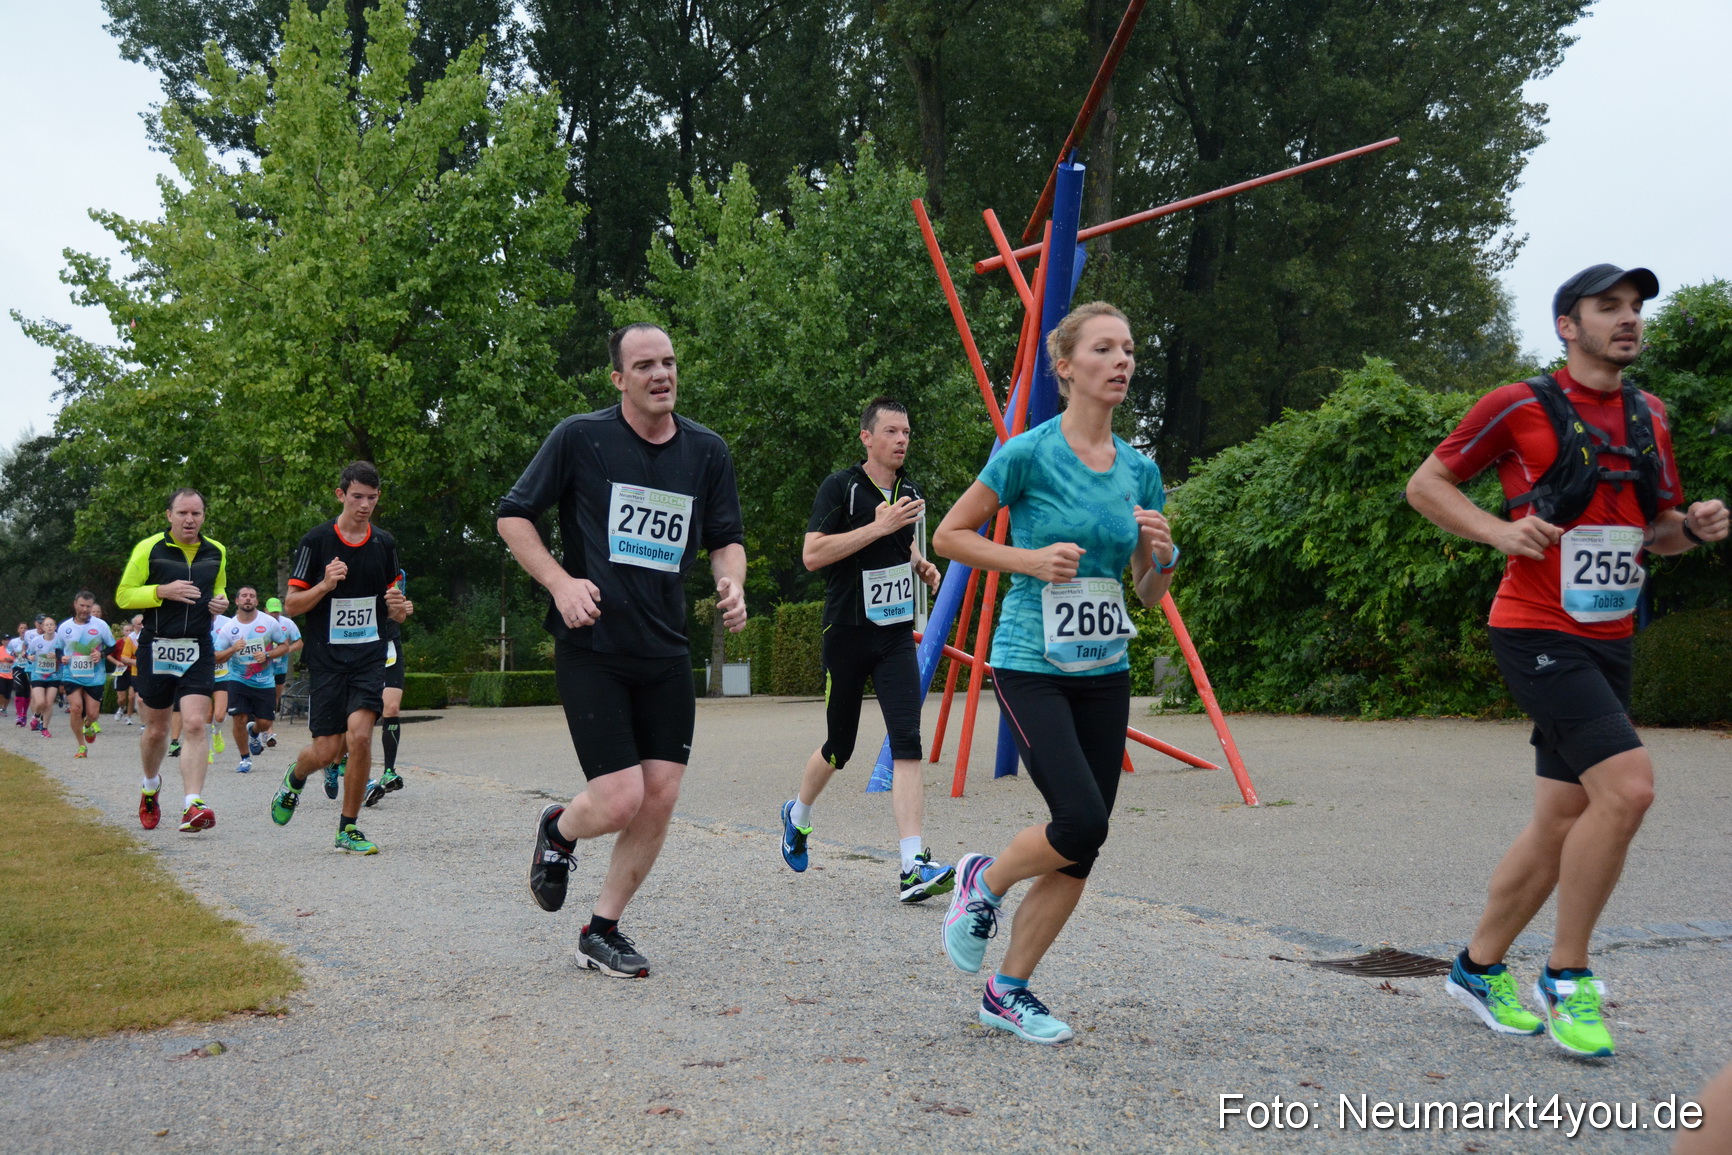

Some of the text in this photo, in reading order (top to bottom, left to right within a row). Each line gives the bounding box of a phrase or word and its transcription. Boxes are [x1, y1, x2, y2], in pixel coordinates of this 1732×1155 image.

[649, 491, 687, 507] BOCK
[618, 503, 684, 543] 2756
[618, 540, 675, 561] Christopher
[870, 577, 912, 605] 2712
[1593, 595, 1625, 609] Tobias
[336, 608, 373, 627] 2557
[883, 607, 906, 617] Stefan
[1055, 601, 1130, 637] 2662
[343, 629, 367, 638] Samuel
[157, 646, 195, 663] 2052
[1076, 645, 1108, 660] Tanja
[72, 660, 93, 669] 3031
